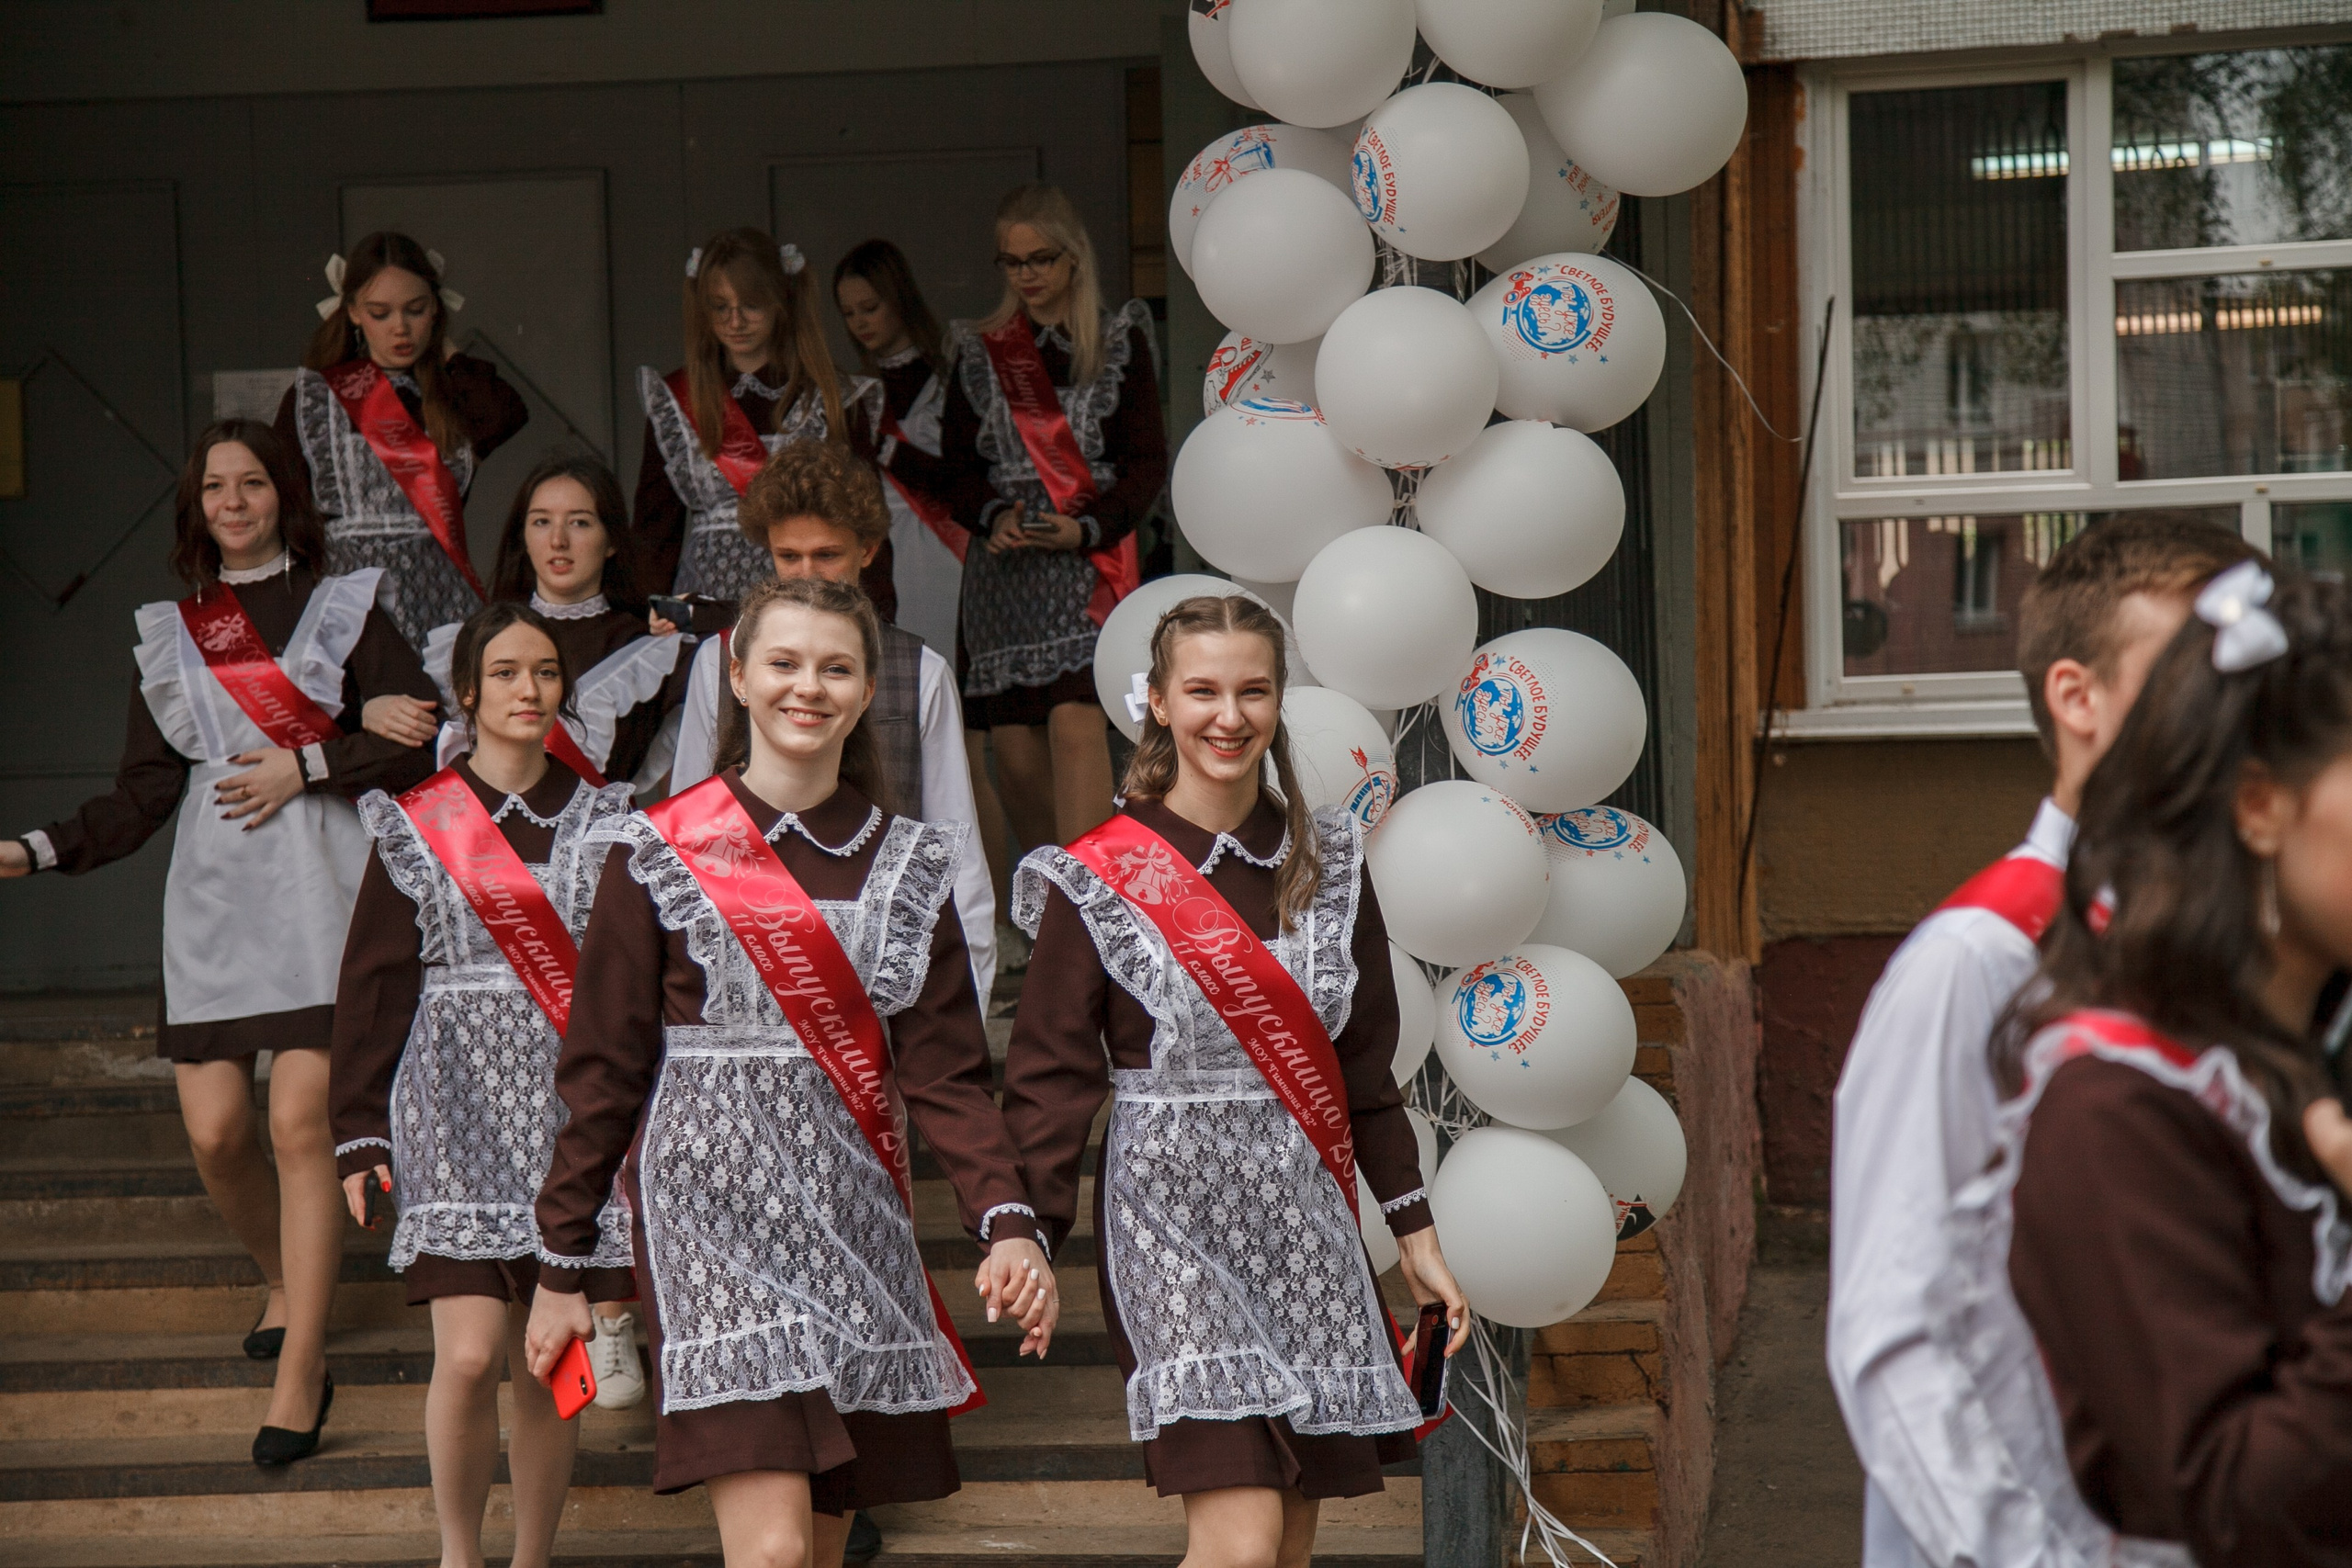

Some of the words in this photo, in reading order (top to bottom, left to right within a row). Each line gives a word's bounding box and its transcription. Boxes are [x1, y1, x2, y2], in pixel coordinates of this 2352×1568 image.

[1368, 130, 1392, 171] СВЕТЛОЕ
[1560, 265, 1609, 296] СВЕТЛОЕ
[1555, 309, 1576, 335] уже
[226, 644, 322, 745] Выпуск
[1509, 660, 1545, 703] СВЕТЛОЕ
[1489, 713, 1510, 741] уже
[1499, 797, 1534, 837] ЗВОНОК
[456, 828, 573, 1009] Выпускниц
[505, 942, 526, 965] МОУ
[729, 912, 752, 929] 11
[743, 933, 774, 973] класс
[1172, 940, 1195, 957] 11
[1187, 960, 1220, 996] класс
[1516, 959, 1550, 998] СВЕТЛОЕ
[738, 874, 892, 1116] Выпускница
[1172, 897, 1343, 1130] Выпускница
[797, 1019, 821, 1045] МОУ
[1489, 1003, 1510, 1032] уже
[1247, 1036, 1273, 1063] МОУ
